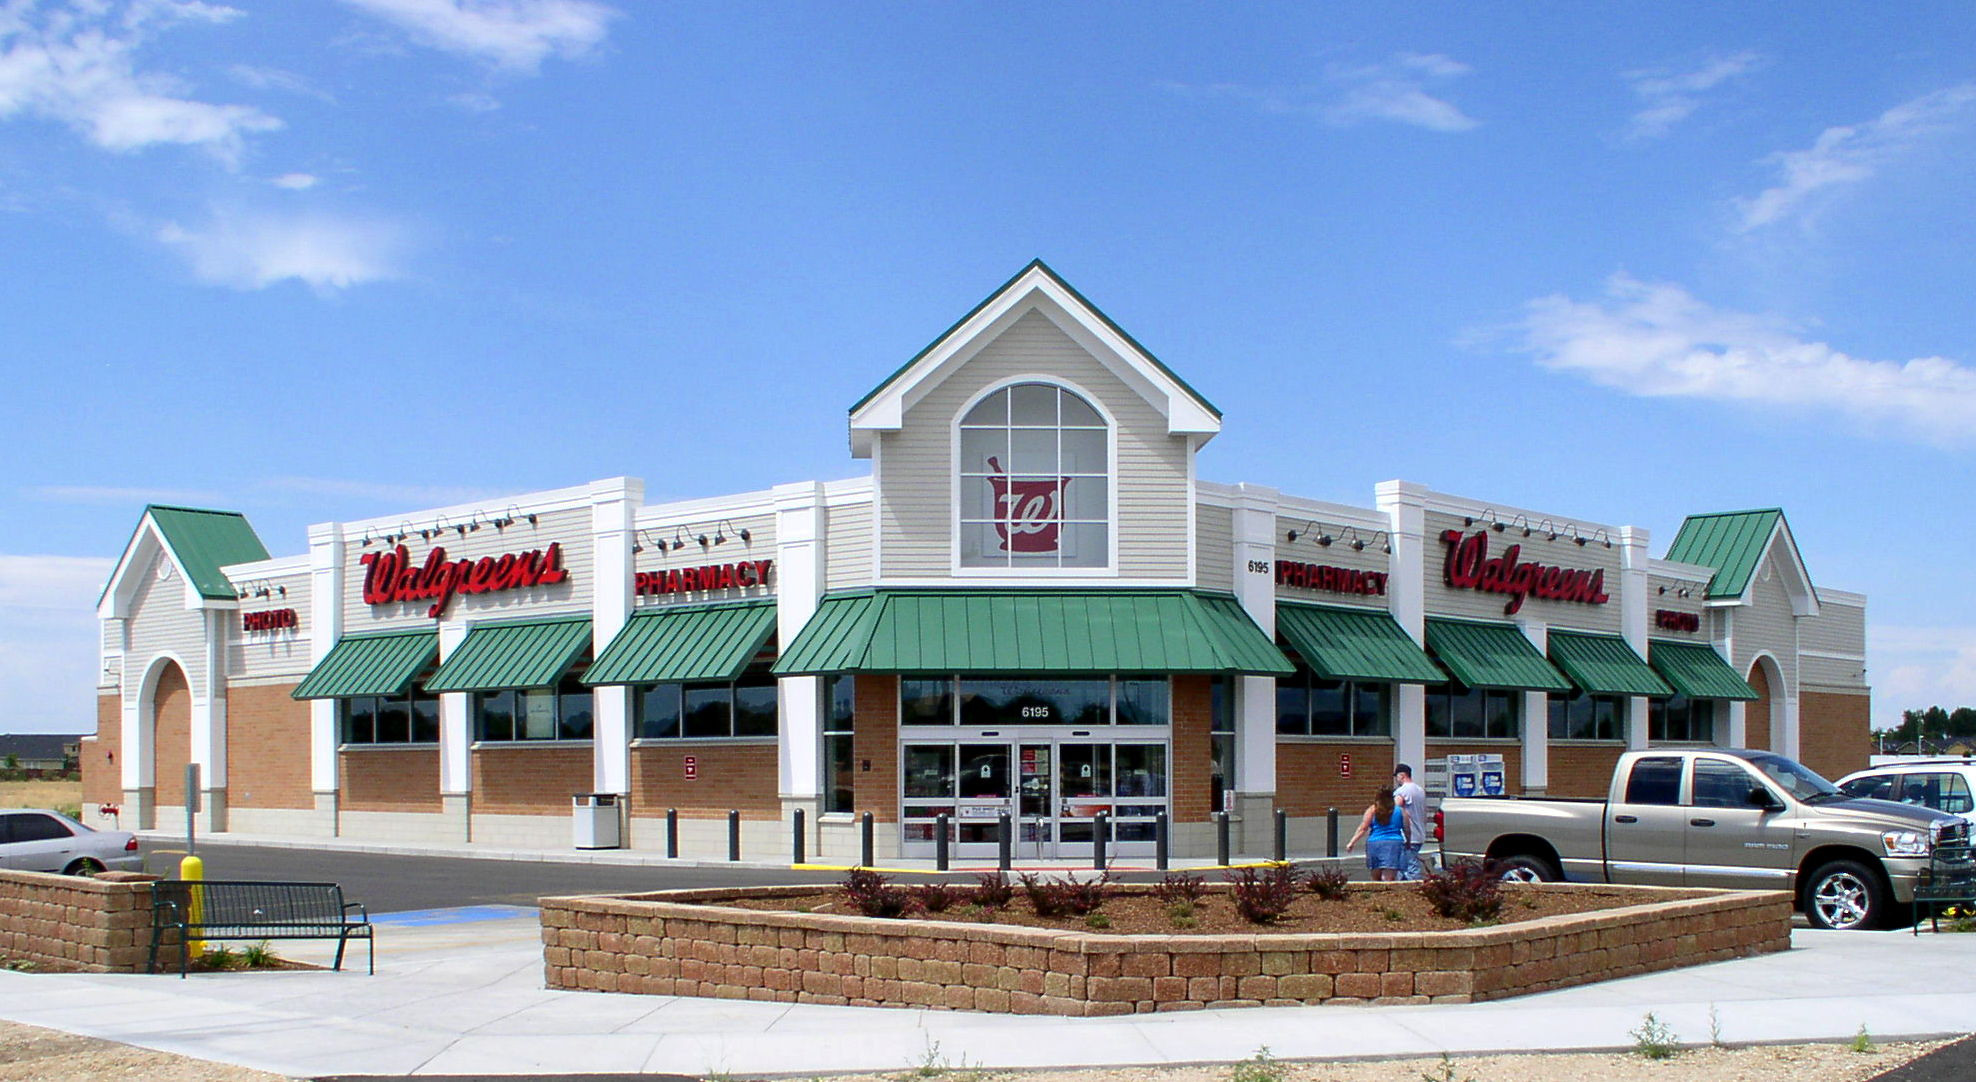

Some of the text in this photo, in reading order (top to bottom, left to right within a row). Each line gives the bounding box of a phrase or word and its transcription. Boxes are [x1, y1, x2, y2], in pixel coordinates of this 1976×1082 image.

[360, 542, 569, 618] Walgreens
[635, 559, 773, 596] PHARMACY
[1248, 560, 1269, 574] 6195
[1275, 560, 1389, 596] PHARMACY
[1439, 530, 1610, 615] Walgreens
[243, 608, 297, 631] PHOTO
[1021, 706, 1049, 717] 6195
